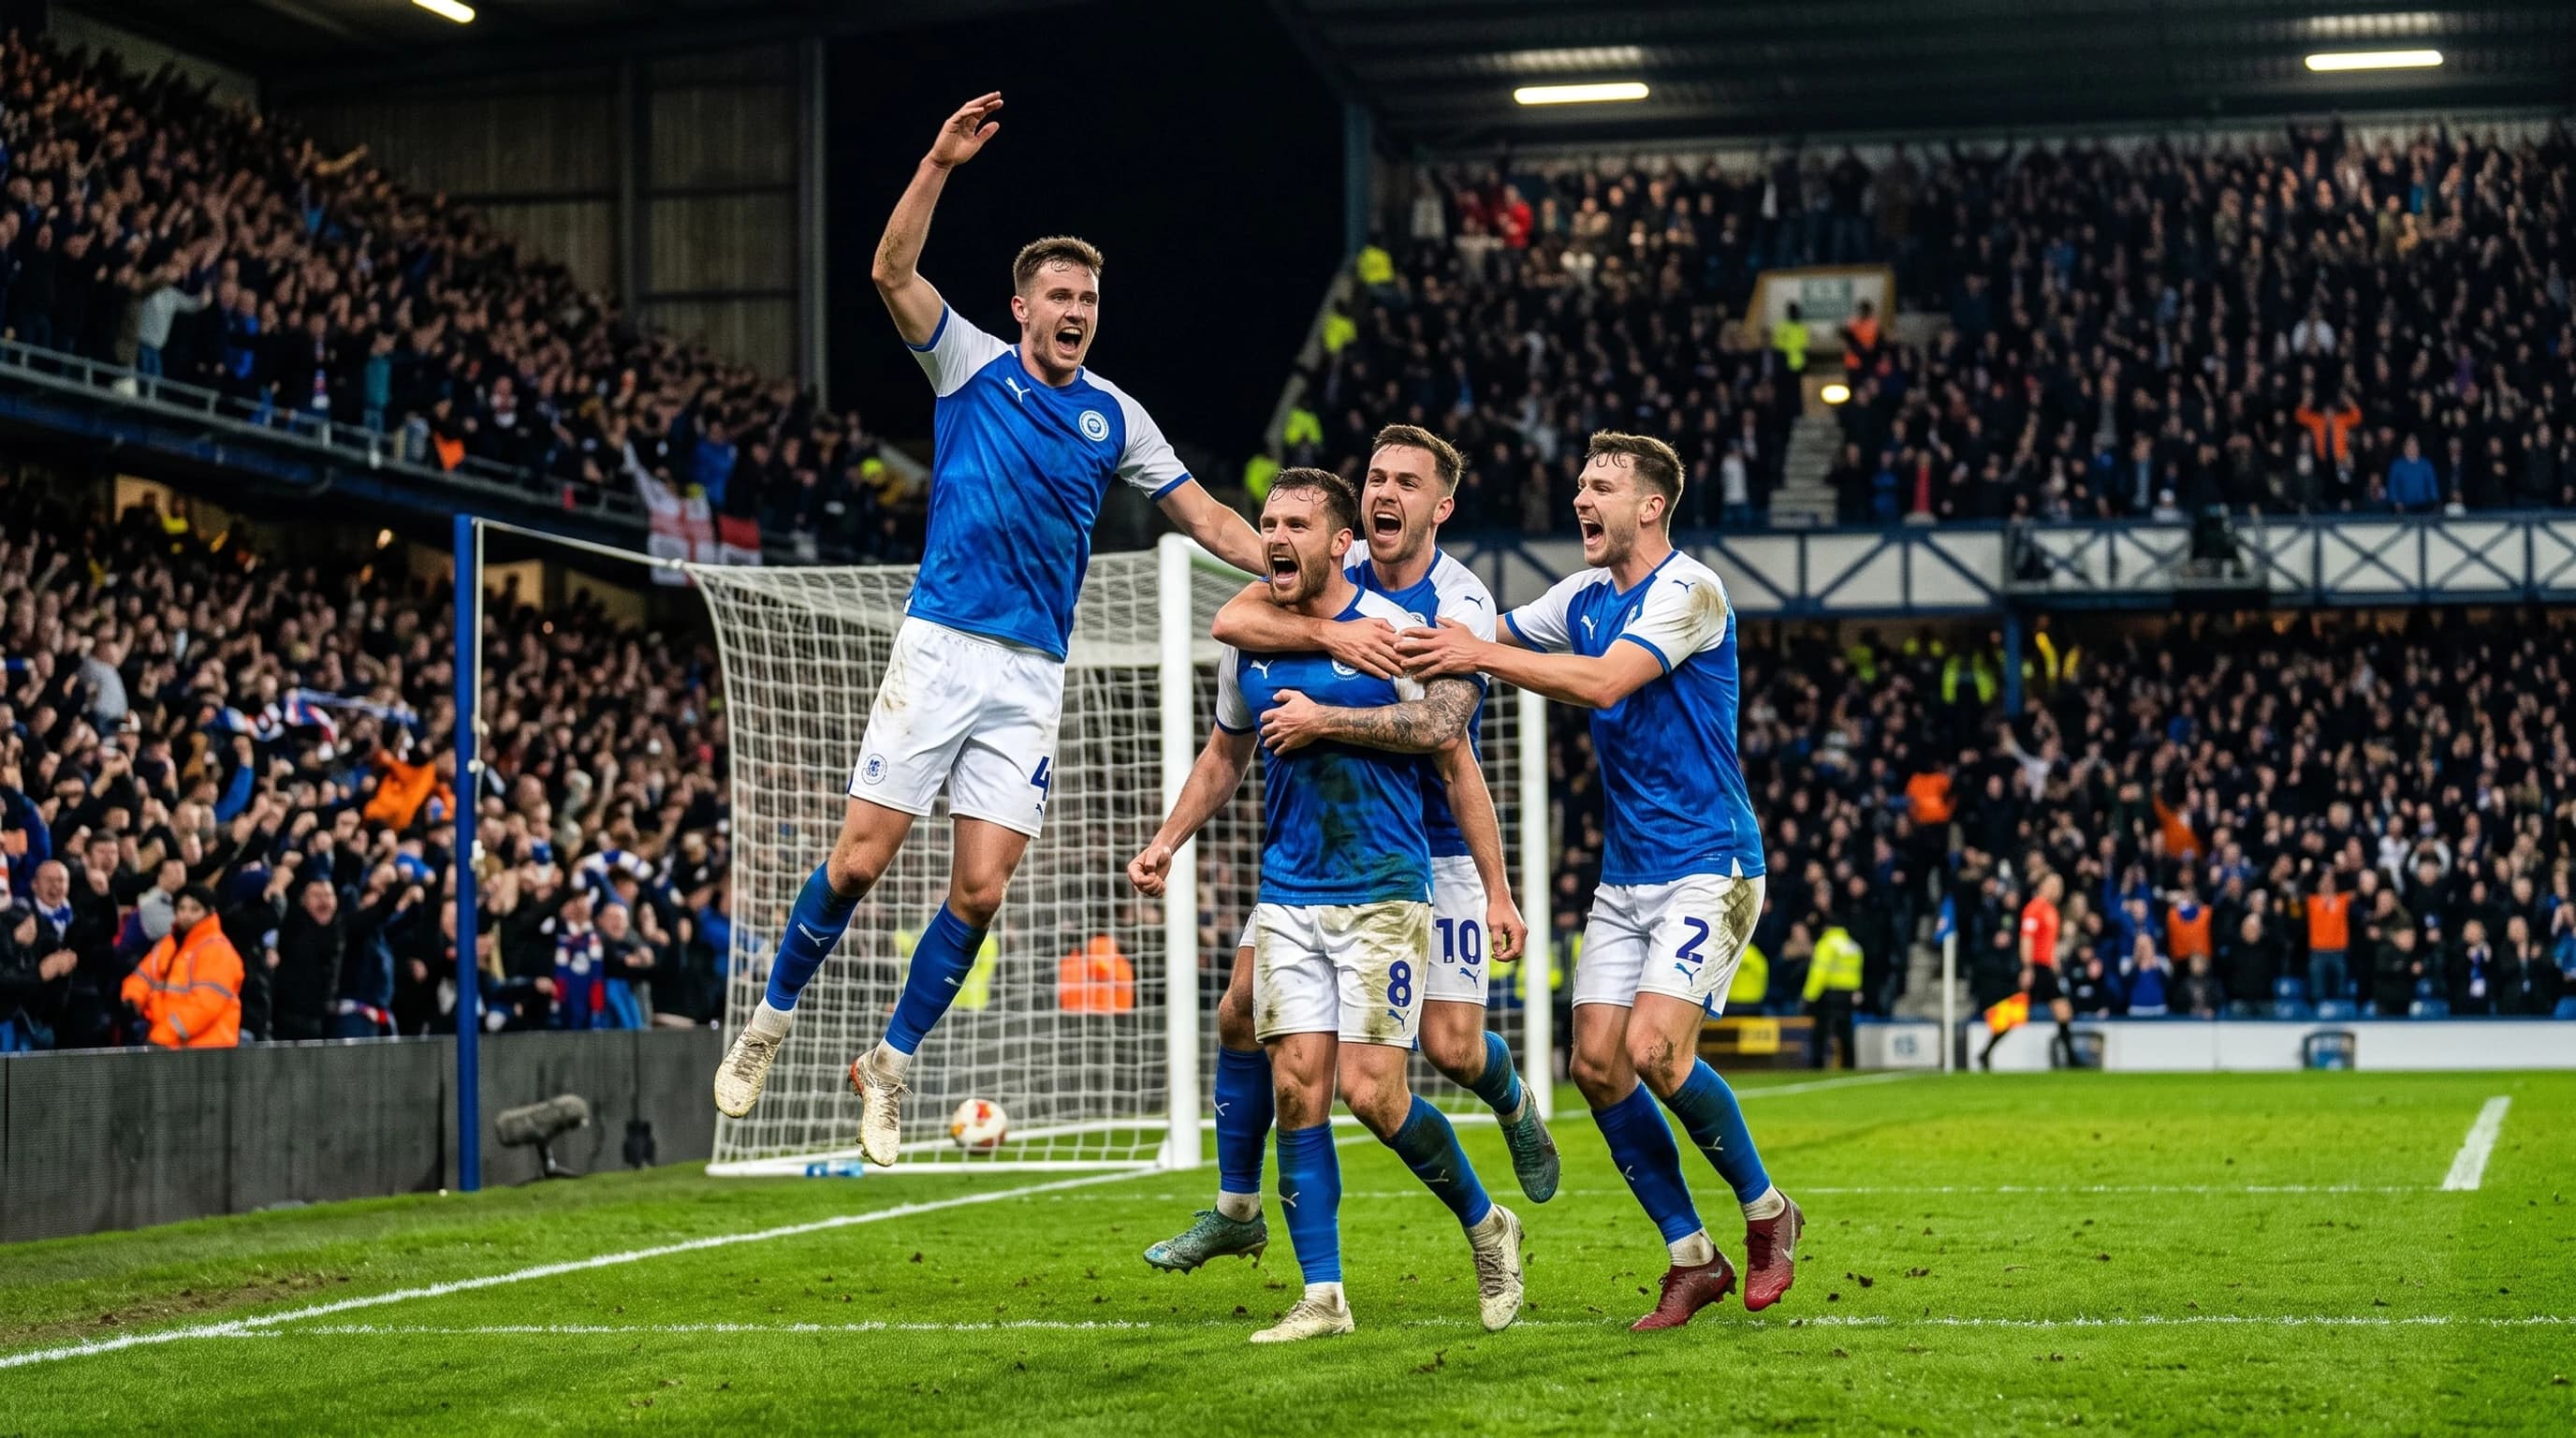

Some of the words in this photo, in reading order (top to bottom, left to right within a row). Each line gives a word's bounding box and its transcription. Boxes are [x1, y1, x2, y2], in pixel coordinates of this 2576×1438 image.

[1031, 756, 1050, 801] 4
[1436, 918, 1481, 965] 10
[1676, 917, 1709, 964] 2
[1387, 961, 1412, 1007] 8
